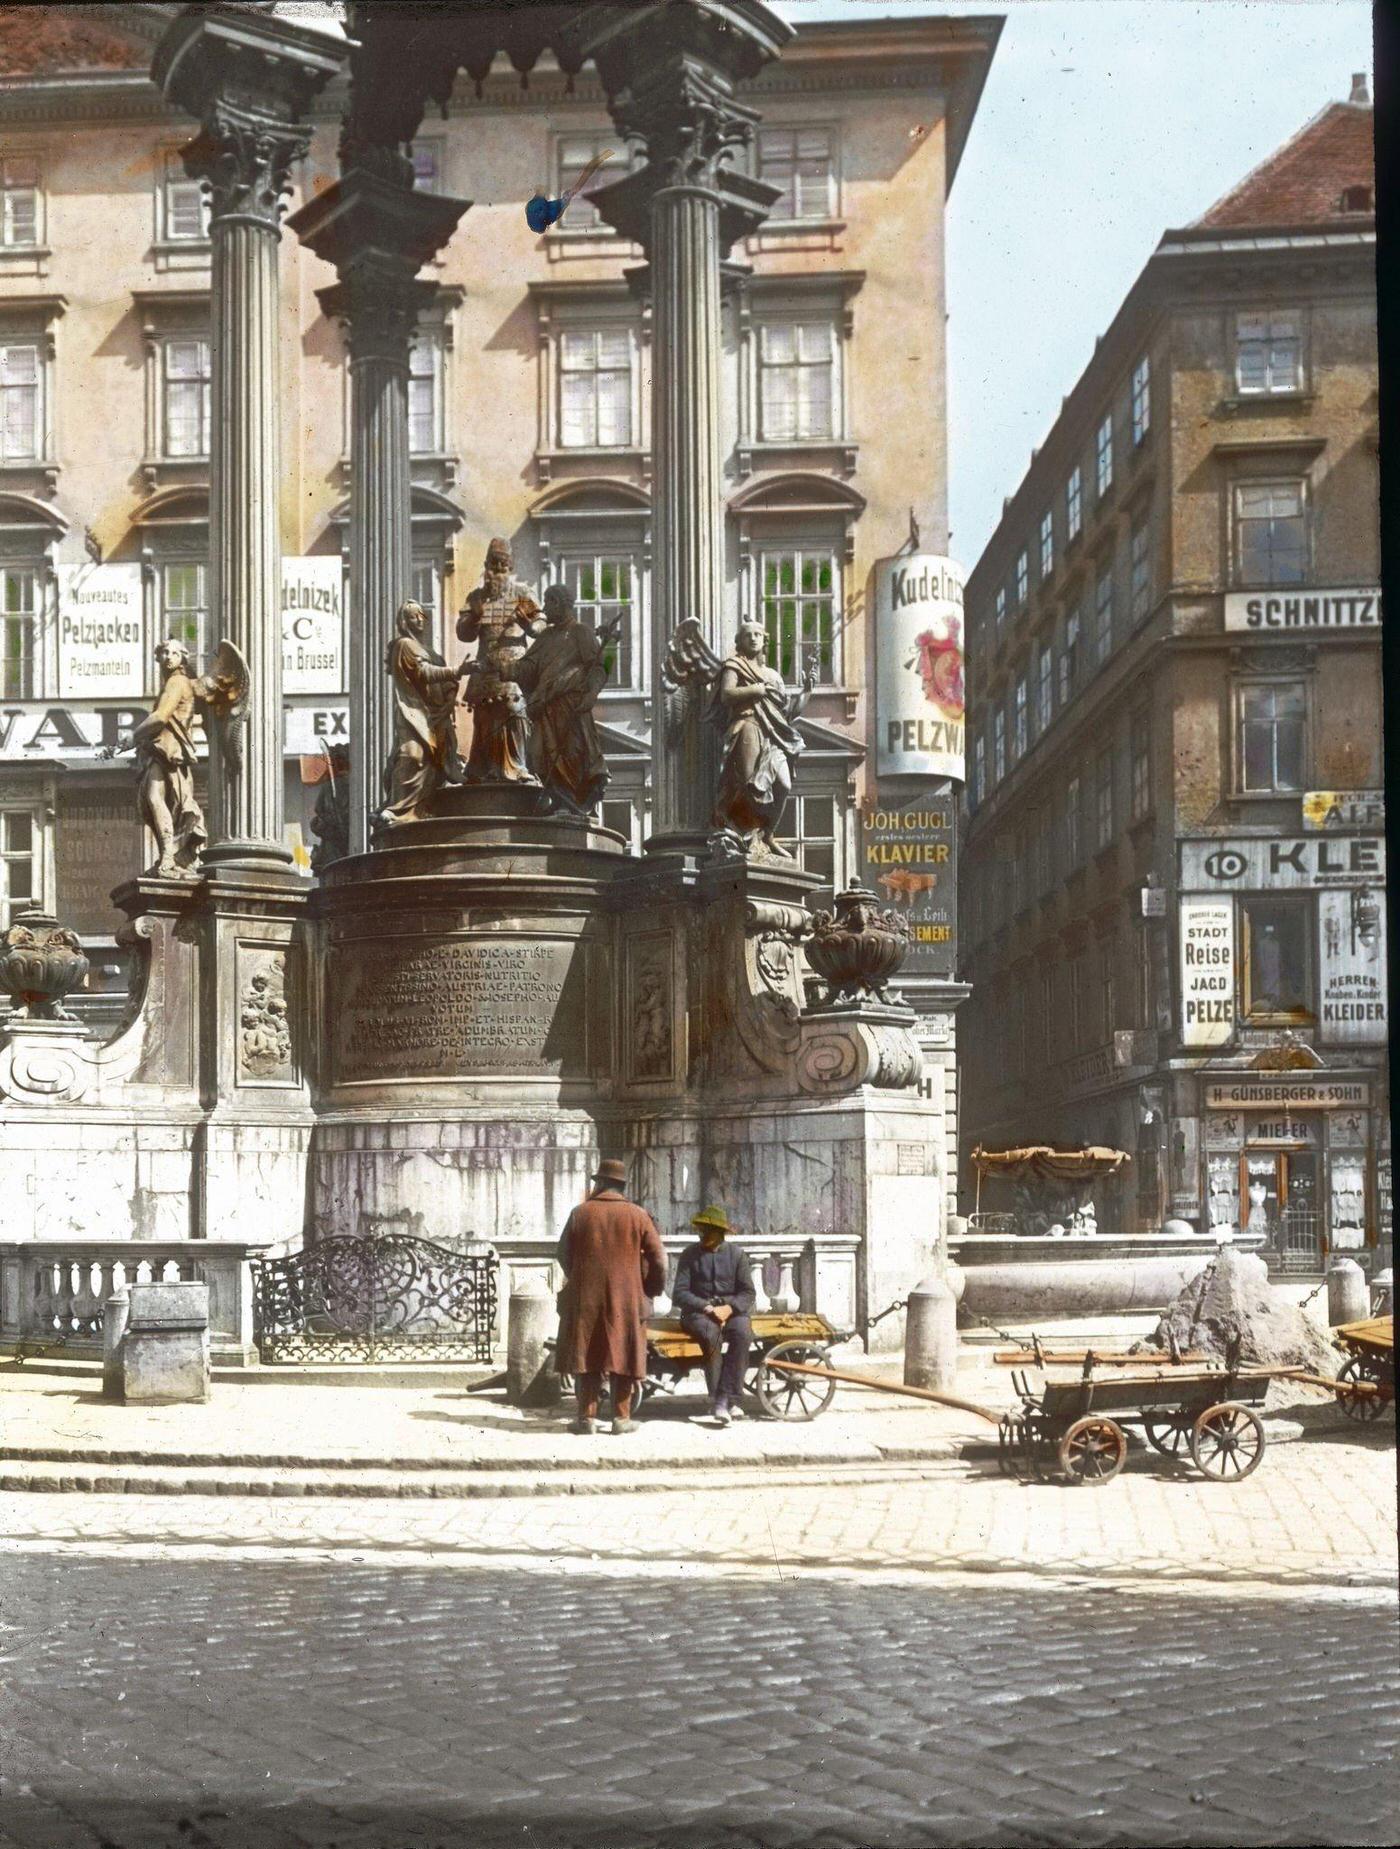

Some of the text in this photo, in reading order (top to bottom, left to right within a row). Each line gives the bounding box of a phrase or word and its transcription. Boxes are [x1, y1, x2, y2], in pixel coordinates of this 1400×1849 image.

[281, 578, 340, 618] delnizek
[867, 844, 949, 863] KLAVIER
[1188, 927, 1228, 938] STADT
[1186, 943, 1230, 965] Reise
[1190, 977, 1226, 990] JAGD
[1186, 1000, 1233, 1024] PELZE
[1324, 1003, 1385, 1021] KLEIDER
[1258, 1123, 1307, 1137] MIEER
